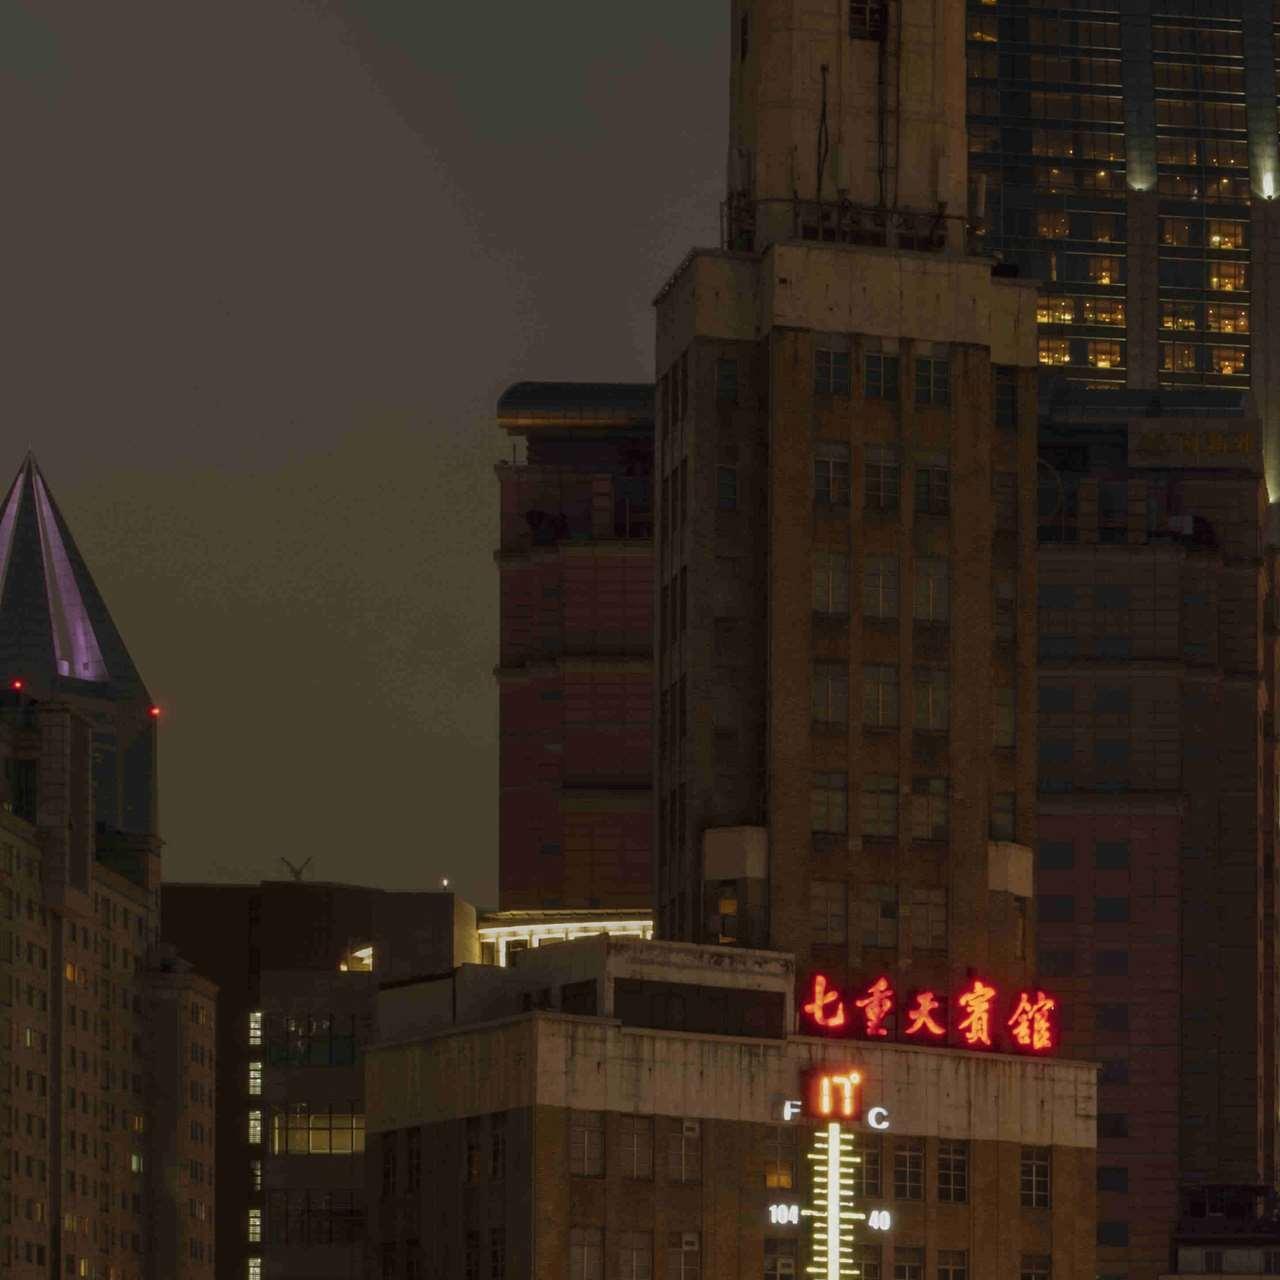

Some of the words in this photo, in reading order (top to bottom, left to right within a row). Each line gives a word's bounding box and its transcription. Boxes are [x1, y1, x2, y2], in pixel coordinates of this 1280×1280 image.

[783, 1100, 801, 1121] F
[867, 1106, 890, 1129] C
[868, 1209, 891, 1230] 40
